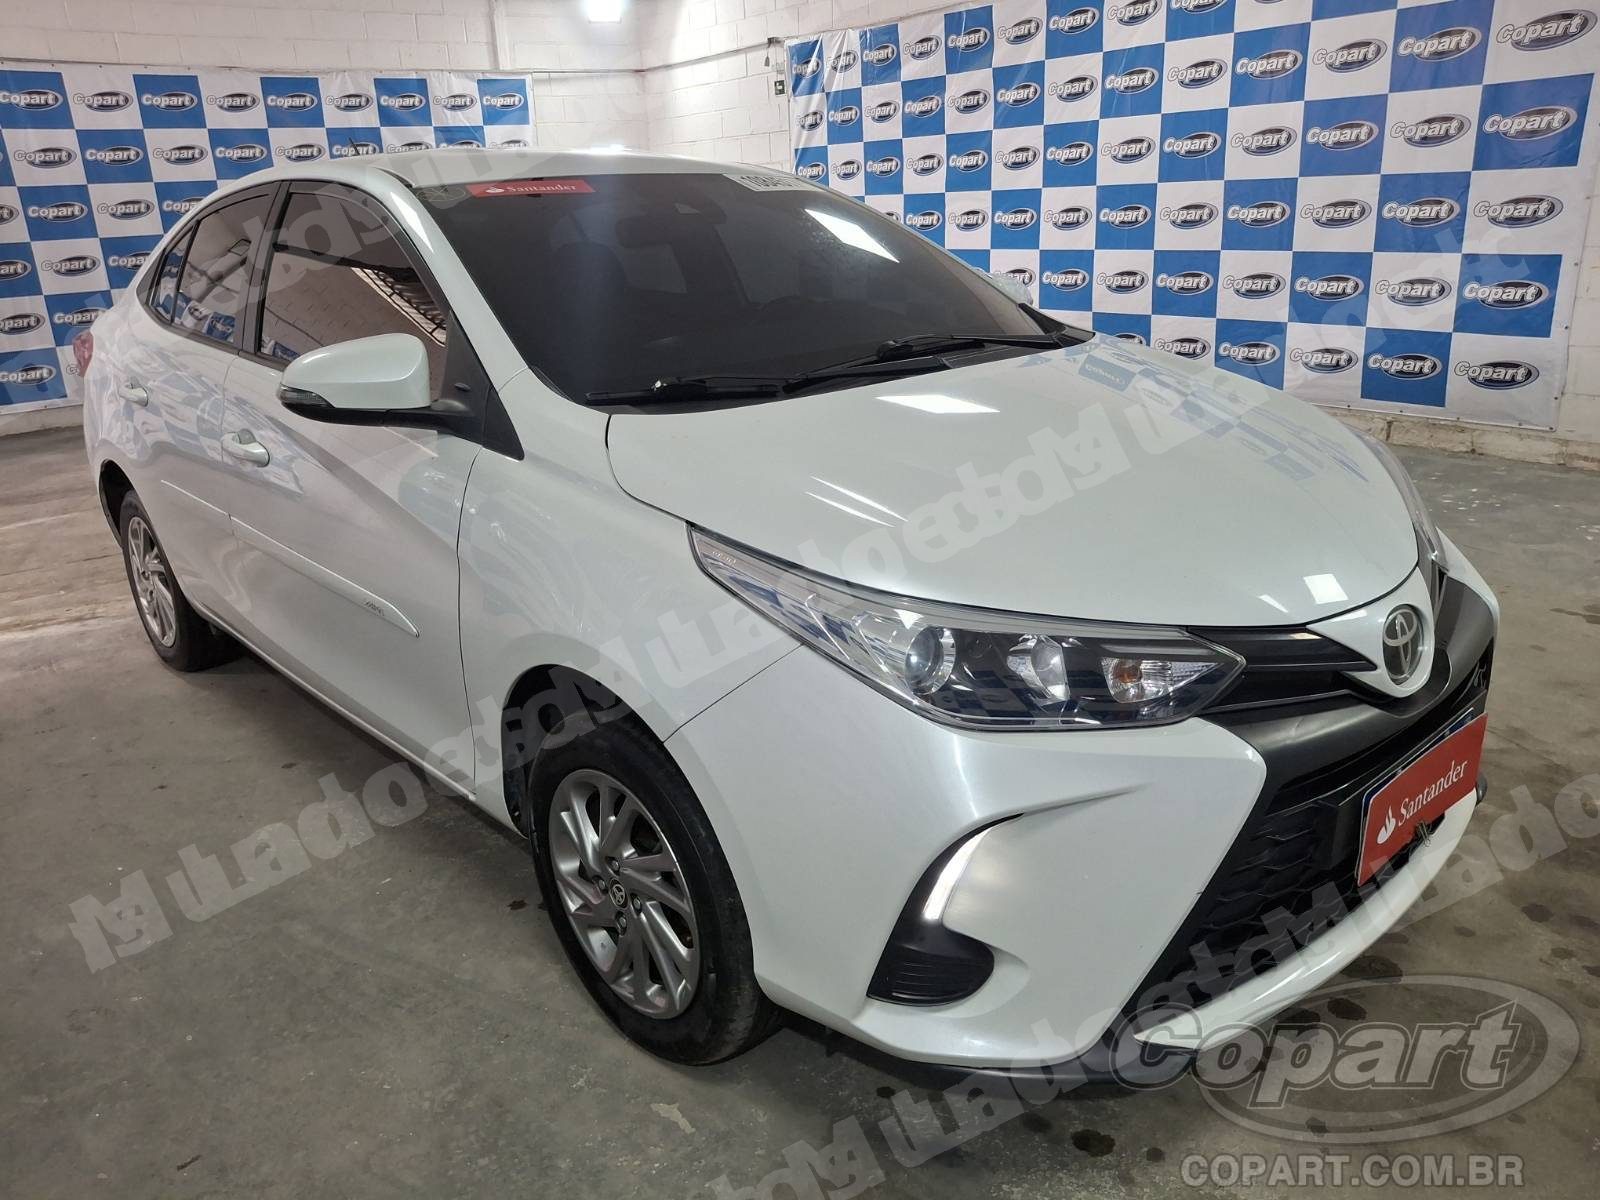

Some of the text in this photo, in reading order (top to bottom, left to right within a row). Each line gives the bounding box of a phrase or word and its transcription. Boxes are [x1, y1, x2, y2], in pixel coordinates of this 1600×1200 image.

[1108, 2, 1154, 19] Copart
[1050, 12, 1093, 30] Copart
[999, 22, 1036, 39] Copart
[1497, 14, 1585, 45] Copart
[904, 38, 937, 55] Copart
[948, 31, 984, 47] Copart
[1399, 32, 1471, 56] Copart
[863, 47, 892, 62] Copart
[1313, 42, 1378, 67] Copart
[1236, 53, 1293, 74] Copart
[1168, 62, 1218, 82] Copart
[1049, 79, 1090, 96] Copart
[1105, 71, 1151, 89] Copart
[73, 93, 124, 107] Copart
[142, 94, 190, 106] Copart
[207, 95, 252, 107] Copart
[268, 96, 311, 107] Copart
[326, 96, 367, 107] Copart
[380, 96, 419, 107] Copart
[434, 96, 472, 106] Copart
[483, 96, 520, 106] Copart
[948, 92, 985, 108] Copart
[998, 87, 1034, 101] Copart
[865, 103, 896, 118] Copart
[905, 98, 938, 114] Copart
[829, 107, 857, 121] Copart
[1483, 108, 1566, 135] Copart
[1307, 125, 1367, 146] Copart
[1391, 119, 1462, 139] Copart
[1164, 135, 1212, 151] Copart
[1231, 131, 1287, 149] Copart
[15, 150, 68, 162] Copart
[86, 150, 136, 160] Copart
[154, 148, 203, 160] Copart
[216, 148, 261, 158] Copart
[275, 147, 320, 158] Copart
[1047, 146, 1086, 160] Copart
[1102, 140, 1146, 158] Copart
[907, 157, 938, 173] Copart
[950, 154, 982, 169] Copart
[996, 151, 1032, 164] Copart
[798, 166, 823, 177] Copart
[866, 160, 896, 173] Copart
[507, 184, 577, 193] Santander
[29, 207, 80, 217] Copart
[100, 203, 146, 215] Copart
[1101, 208, 1144, 223] Copart
[1160, 208, 1210, 223] Copart
[1228, 205, 1282, 221] Copart
[1301, 201, 1361, 220] Copart
[1382, 202, 1449, 218] Copart
[1474, 199, 1550, 222] Copart
[906, 213, 938, 226] Copart
[949, 212, 981, 225] Copart
[994, 211, 1030, 223] Copart
[1045, 210, 1085, 224] Copart
[42, 257, 92, 273] Copart
[1043, 272, 1083, 285] Copart
[1097, 274, 1141, 288] Copart
[1157, 274, 1205, 290] Copart
[1223, 278, 1278, 291] Copart
[1295, 278, 1354, 294] Copart
[1377, 281, 1440, 297] Copart
[1464, 282, 1536, 301] Copart
[1219, 344, 1268, 359] Copart
[1291, 349, 1347, 364] Copart
[1368, 354, 1432, 372] Copart
[1455, 362, 1527, 381] Copart
[1398, 760, 1468, 826] Santander
